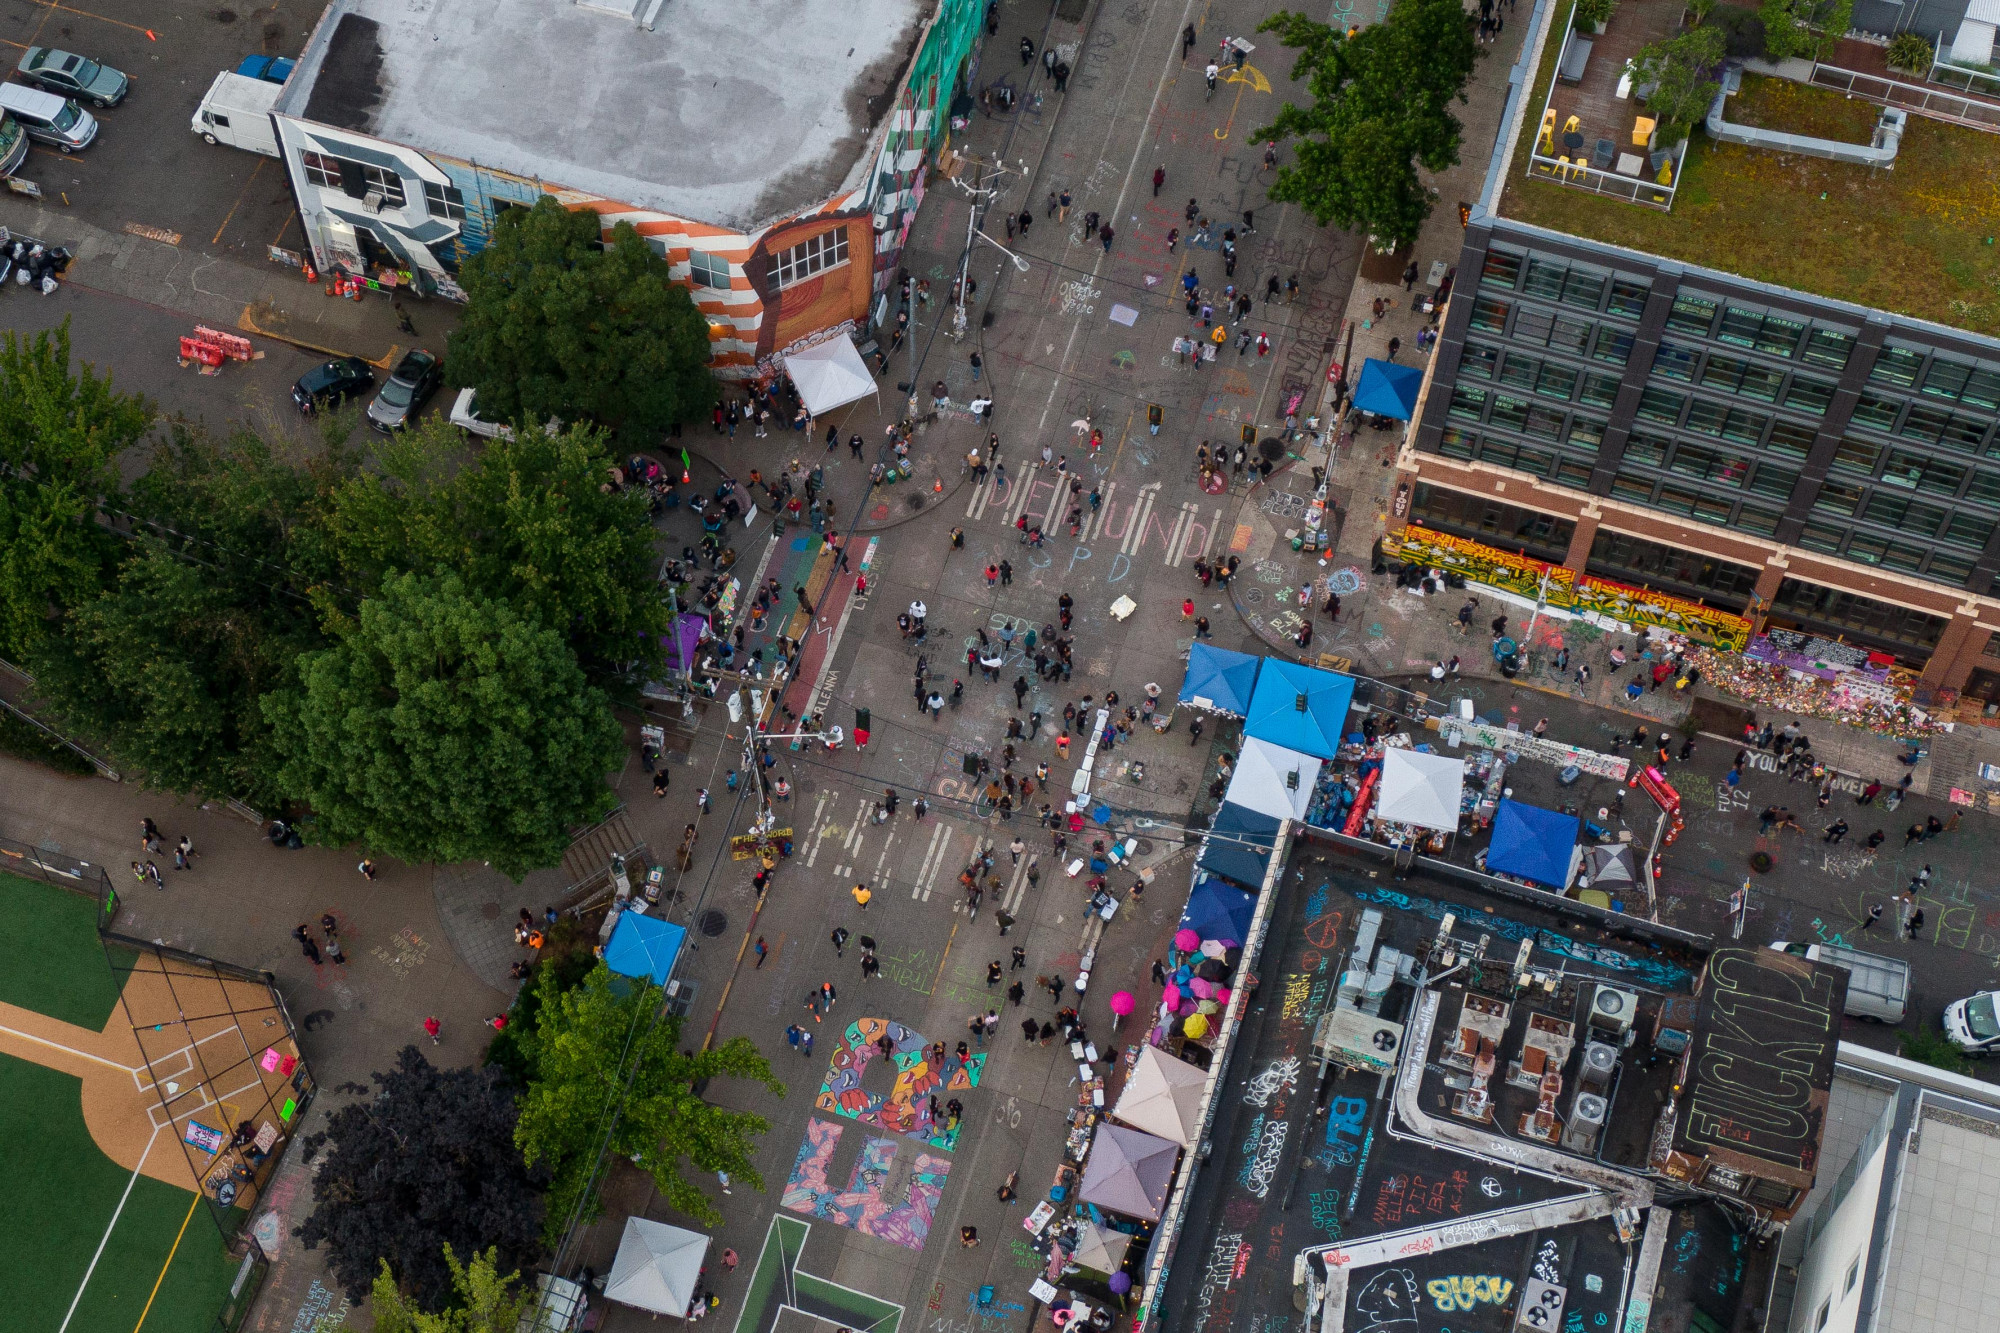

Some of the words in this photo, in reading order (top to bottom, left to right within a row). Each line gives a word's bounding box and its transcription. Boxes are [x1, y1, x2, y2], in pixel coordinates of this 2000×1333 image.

[1746, 751, 1777, 773] YOU
[1729, 787, 1751, 810] 12
[1403, 1062, 1419, 1089] Trump
[1686, 1010, 1825, 1171] FUCK
[1406, 1175, 1428, 1214] RIP
[1309, 1192, 1324, 1229] FLOYD
[306, 1277, 320, 1300] WERE
[307, 1286, 326, 1317] KILLED
